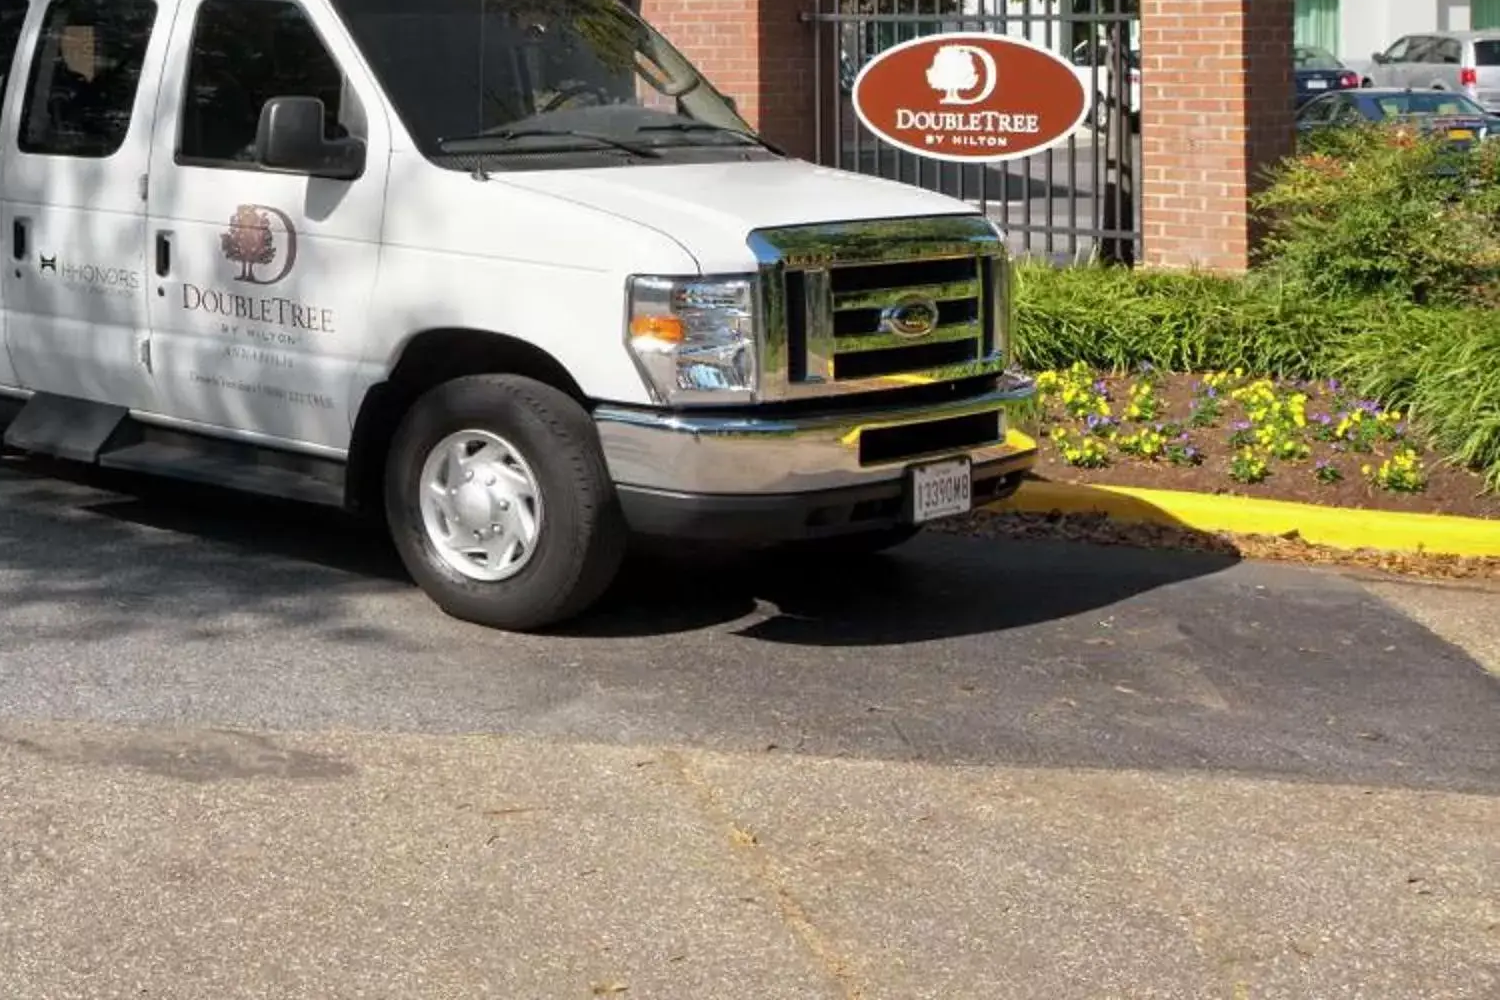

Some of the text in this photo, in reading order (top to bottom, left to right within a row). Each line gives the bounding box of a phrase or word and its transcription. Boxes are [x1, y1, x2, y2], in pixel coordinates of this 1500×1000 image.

[896, 108, 1039, 133] DOUBLETREE
[924, 134, 1007, 147] BY HILTON
[182, 283, 336, 333] DOUBLETREE
